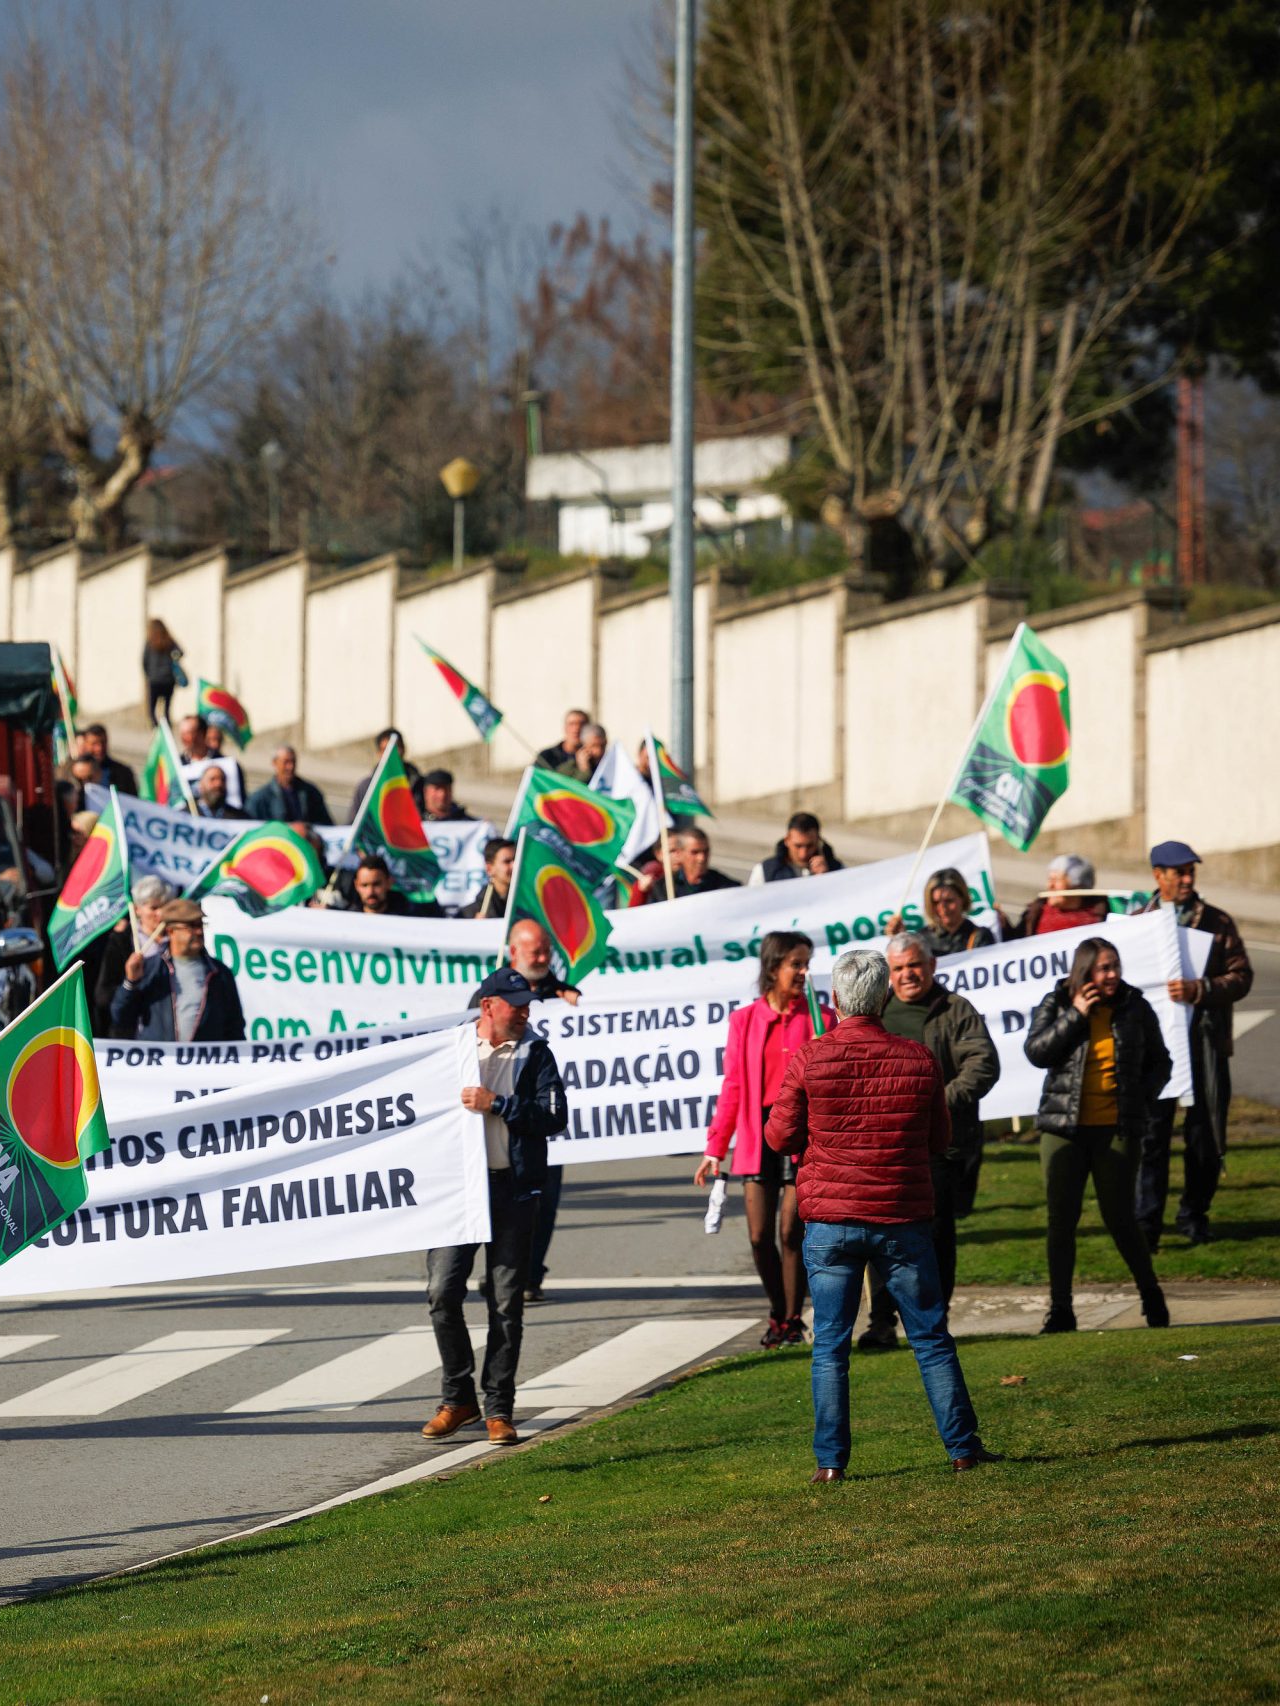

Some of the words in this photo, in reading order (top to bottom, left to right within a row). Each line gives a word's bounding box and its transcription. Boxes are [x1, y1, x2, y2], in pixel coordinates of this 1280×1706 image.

[125, 811, 237, 851] AGRIC
[213, 933, 509, 986] Desenvolvime
[598, 934, 708, 975] Rural
[561, 1004, 696, 1039] SISTEMAS
[934, 950, 1070, 994] RADICION
[251, 1016, 311, 1042] om
[106, 1047, 166, 1068] POR
[176, 1044, 240, 1066] UMA
[251, 1042, 305, 1064] PAC
[562, 1044, 701, 1092] ADAÇÃO
[177, 1092, 417, 1160] CAMPONESES
[222, 1167, 418, 1229] FAMILIAR
